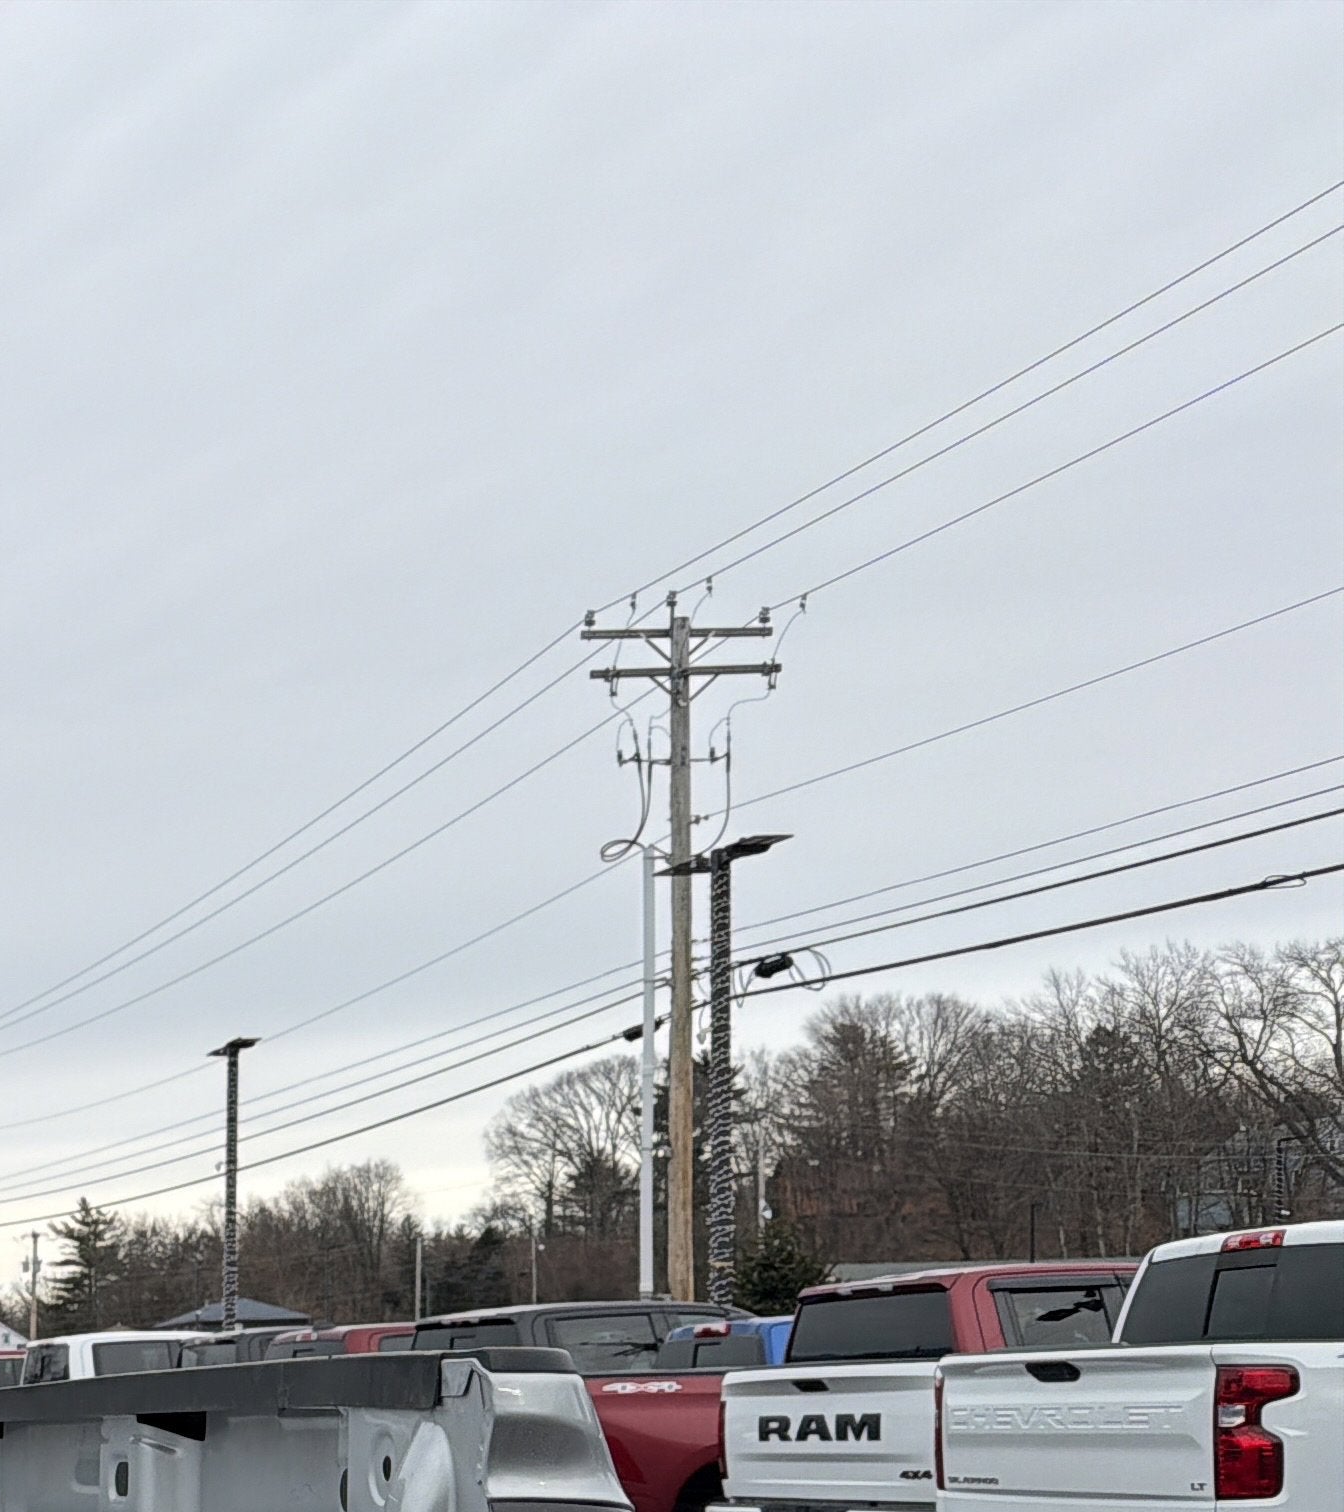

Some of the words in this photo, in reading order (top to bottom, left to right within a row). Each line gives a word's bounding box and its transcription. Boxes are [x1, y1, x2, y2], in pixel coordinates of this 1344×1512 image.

[758, 1413, 881, 1442] RAM
[950, 1405, 1183, 1430] CHEVROLET
[1191, 1482, 1208, 1491] LT
